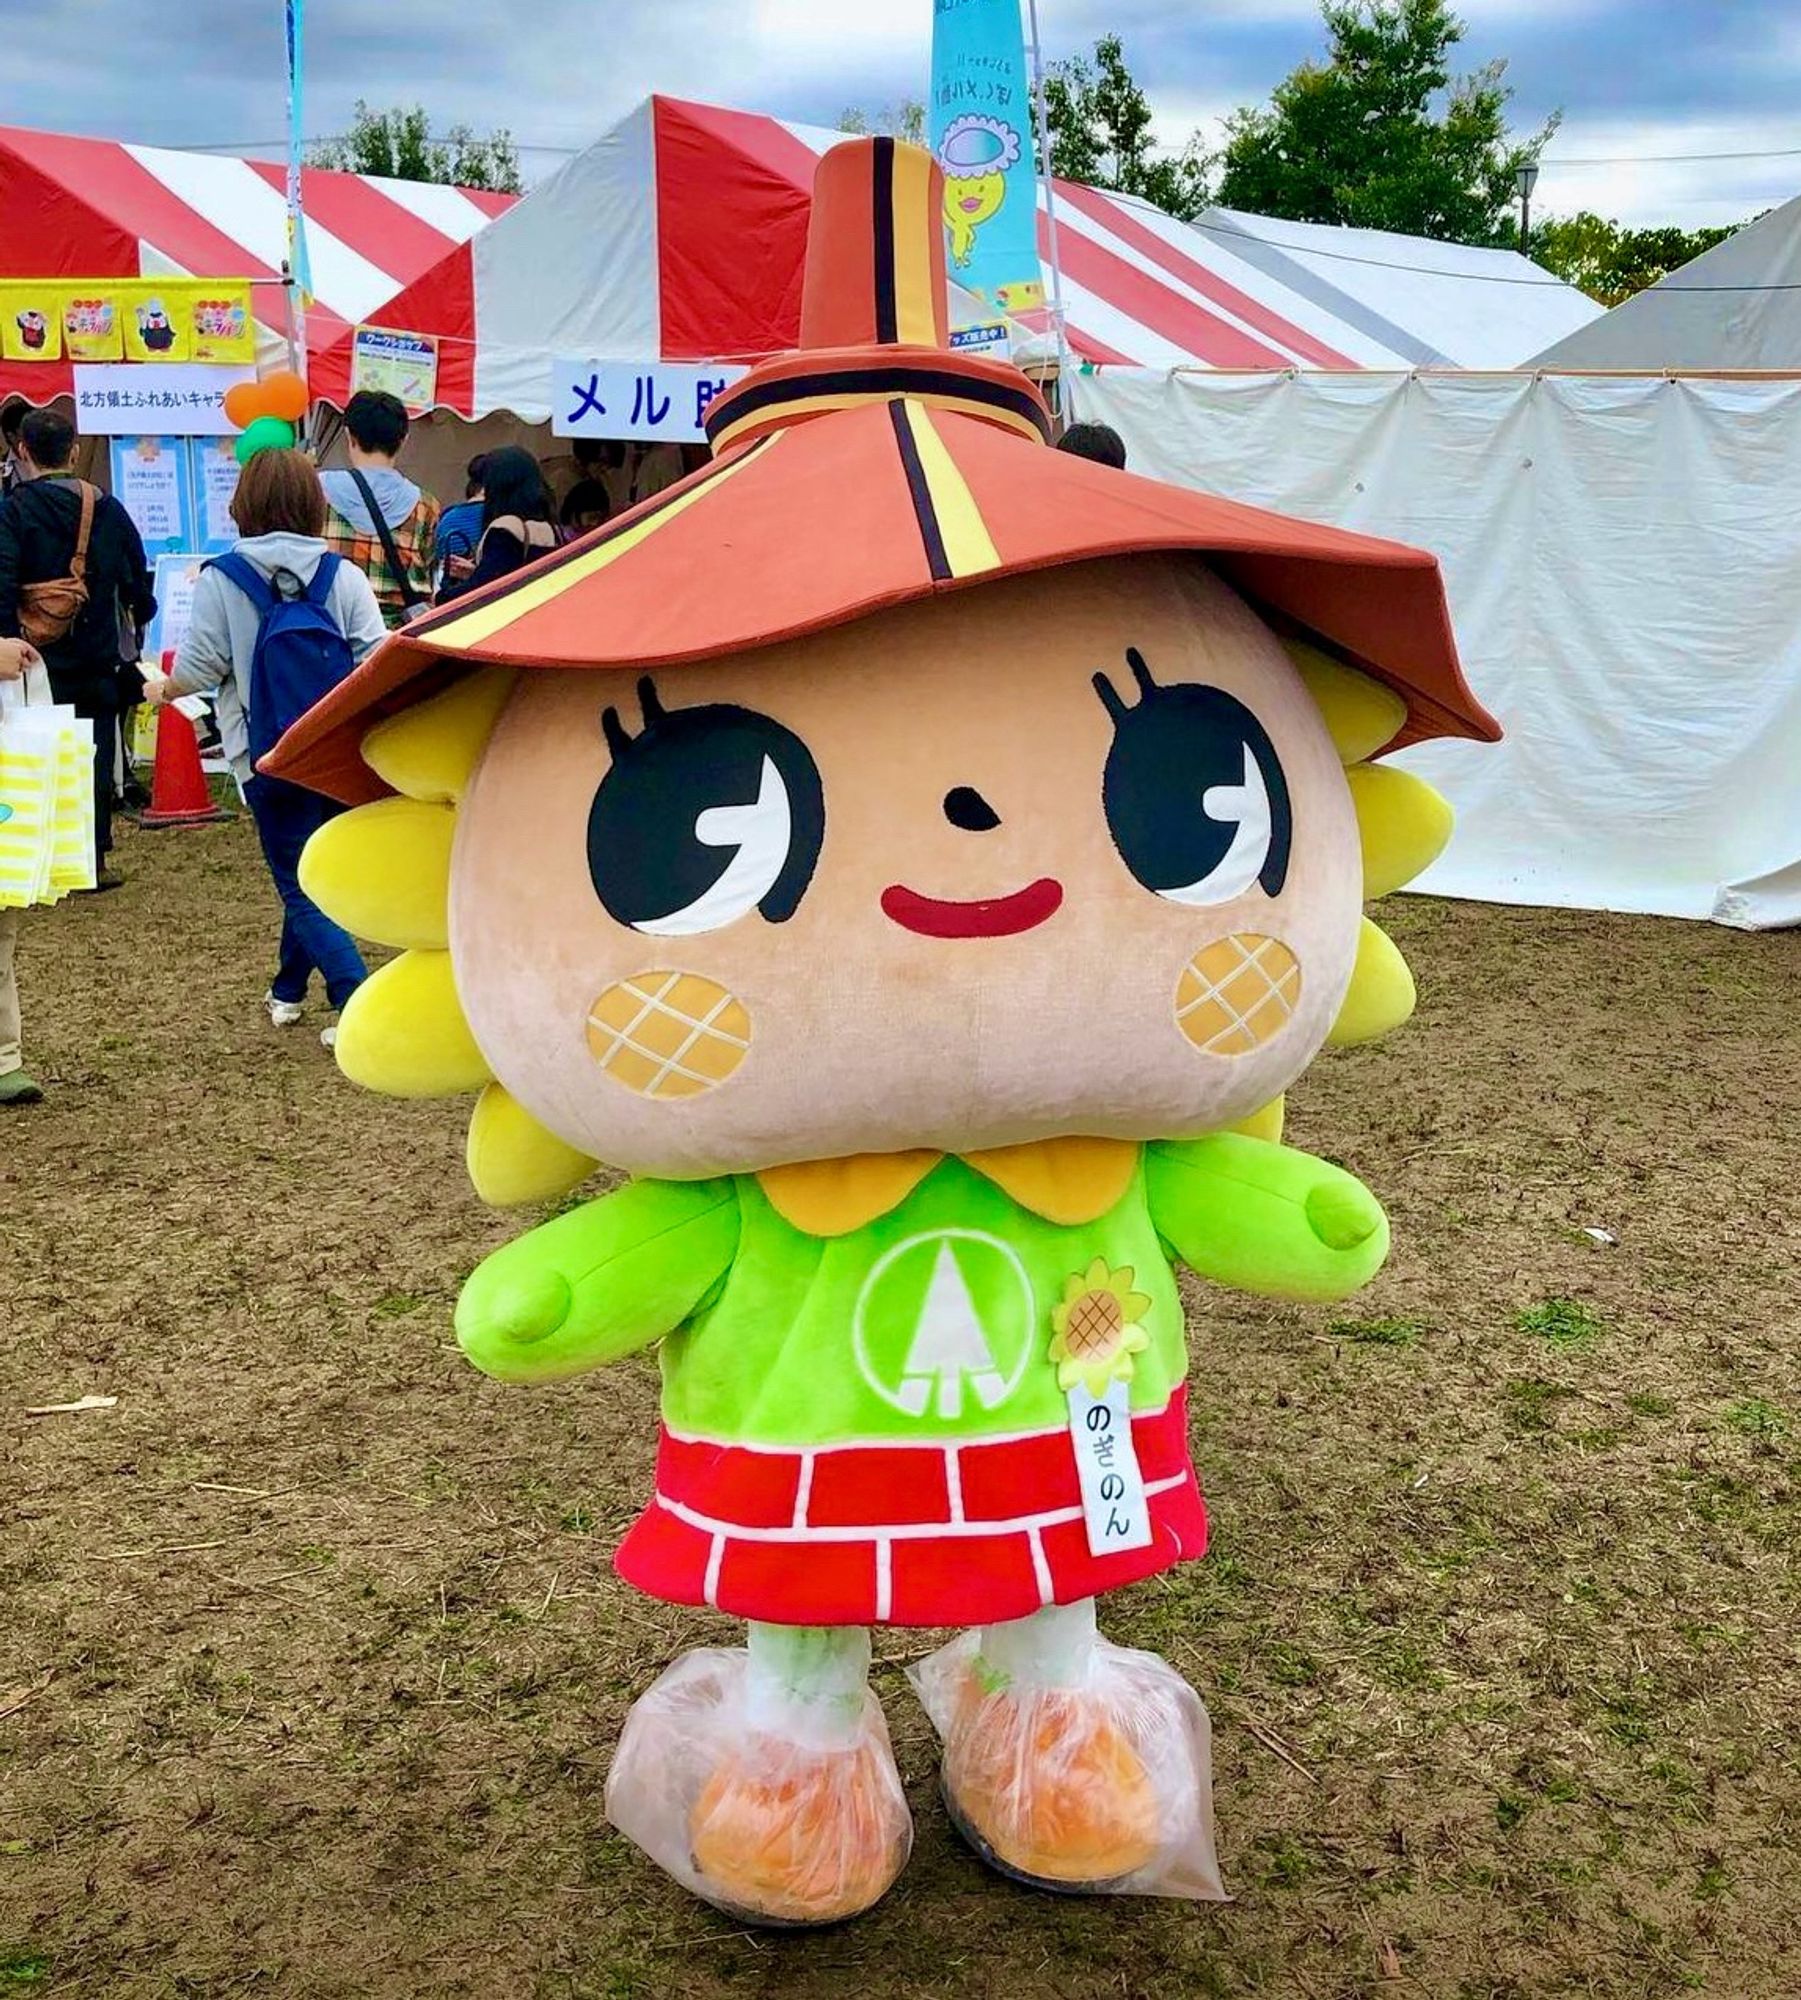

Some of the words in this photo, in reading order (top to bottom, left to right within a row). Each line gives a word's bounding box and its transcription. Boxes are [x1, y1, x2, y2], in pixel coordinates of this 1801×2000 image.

[80, 391, 225, 408] 北方領土ふれあいキャラ
[1087, 1405, 1130, 1537] のぎのん
